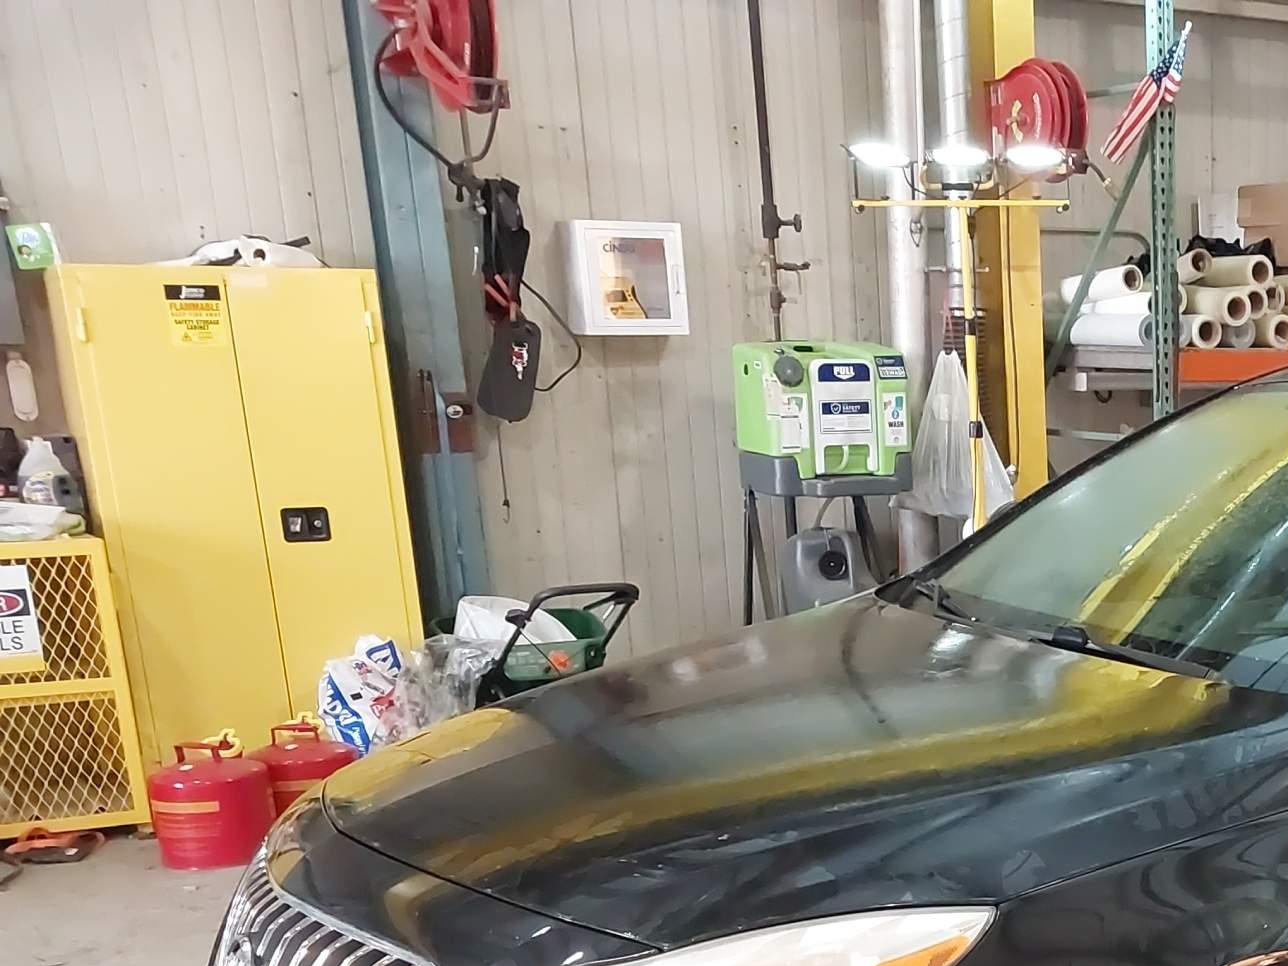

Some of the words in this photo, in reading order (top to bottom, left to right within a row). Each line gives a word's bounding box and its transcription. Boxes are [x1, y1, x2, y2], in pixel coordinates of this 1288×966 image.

[169, 302, 221, 311] FLAMMABLE
[833, 365, 855, 376] PULL
[888, 420, 904, 428] WASH
